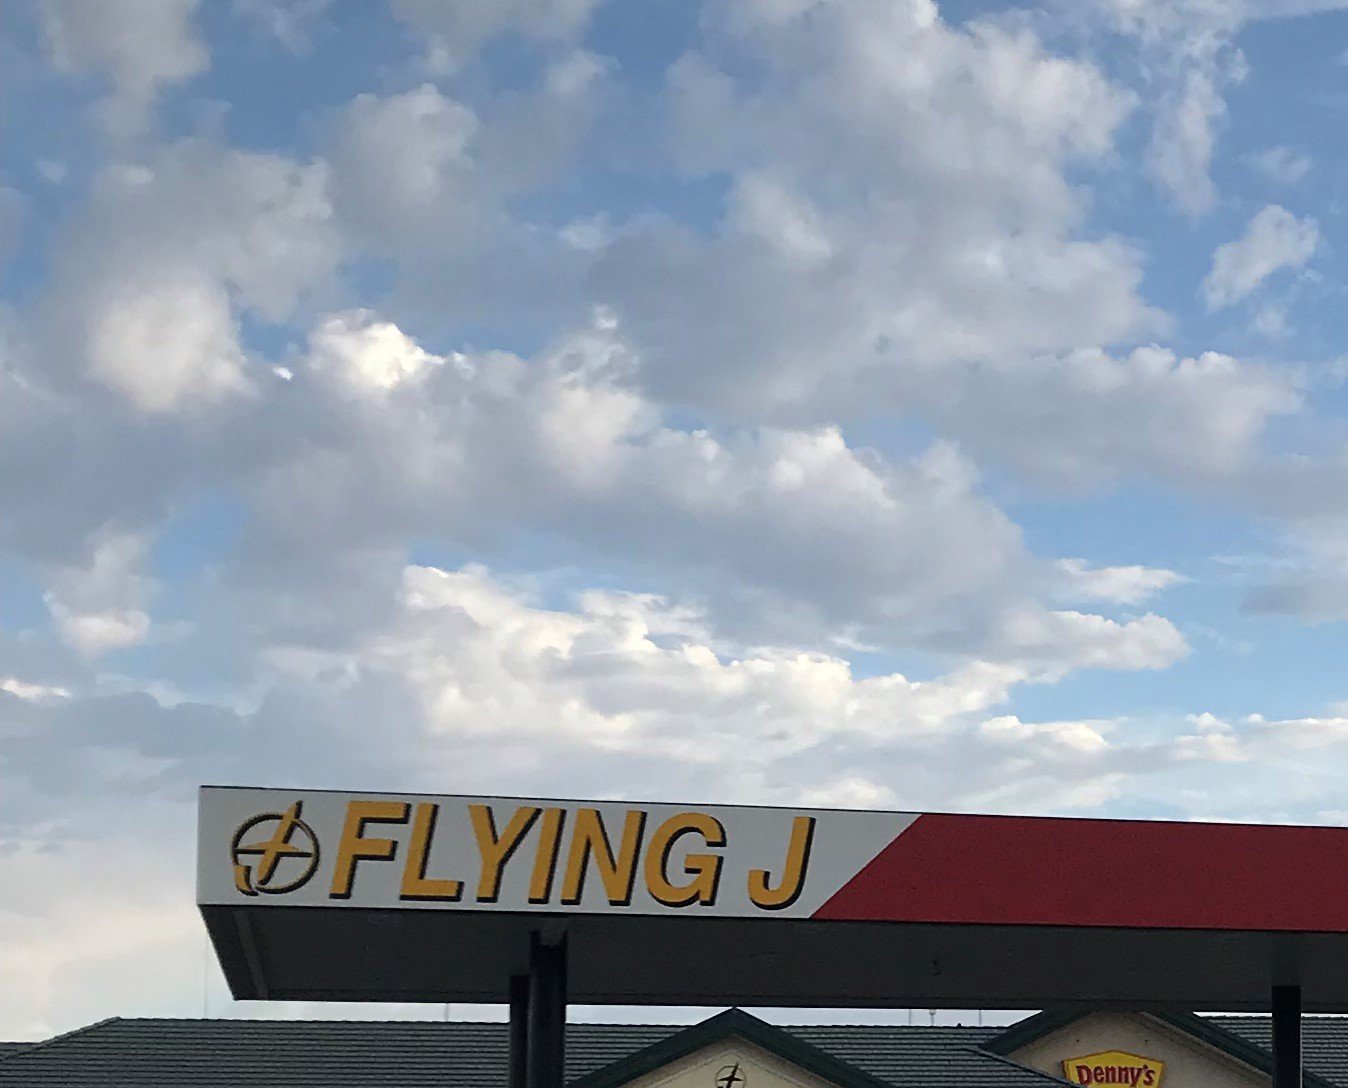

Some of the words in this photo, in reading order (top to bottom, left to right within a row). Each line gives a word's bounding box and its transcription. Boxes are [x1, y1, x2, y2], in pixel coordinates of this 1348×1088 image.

[328, 800, 728, 908] FLYING
[747, 815, 817, 911] J
[1075, 1063, 1156, 1088] Denny's
